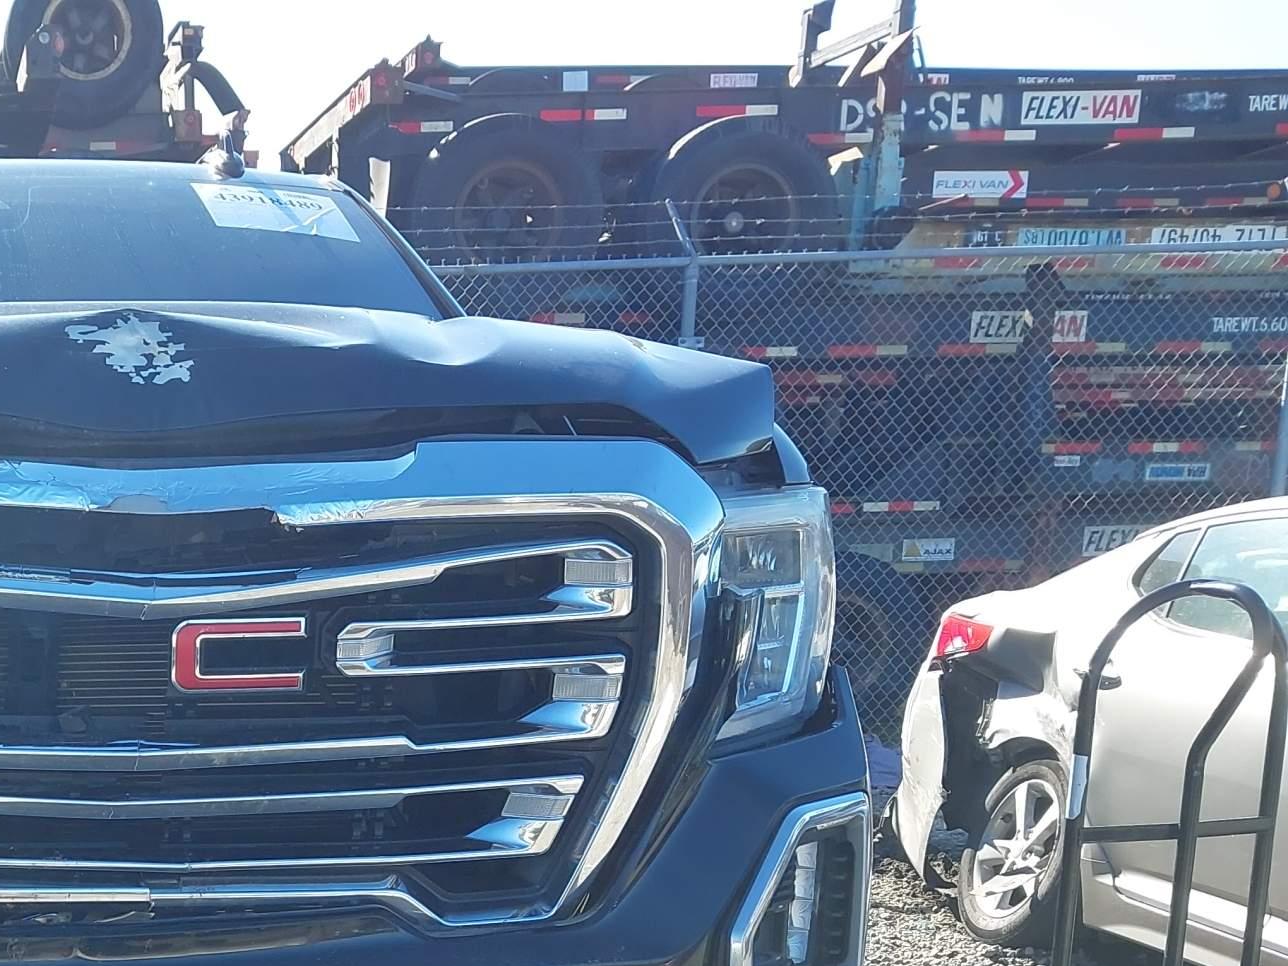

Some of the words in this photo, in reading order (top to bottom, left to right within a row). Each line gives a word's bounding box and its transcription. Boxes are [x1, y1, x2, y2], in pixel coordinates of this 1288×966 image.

[1023, 94, 1139, 119] FLEXI-VAN
[936, 180, 979, 190] FLEXI
[980, 180, 1011, 190] VAN
[922, 548, 954, 556] AJAX
[172, 617, 307, 692] C
